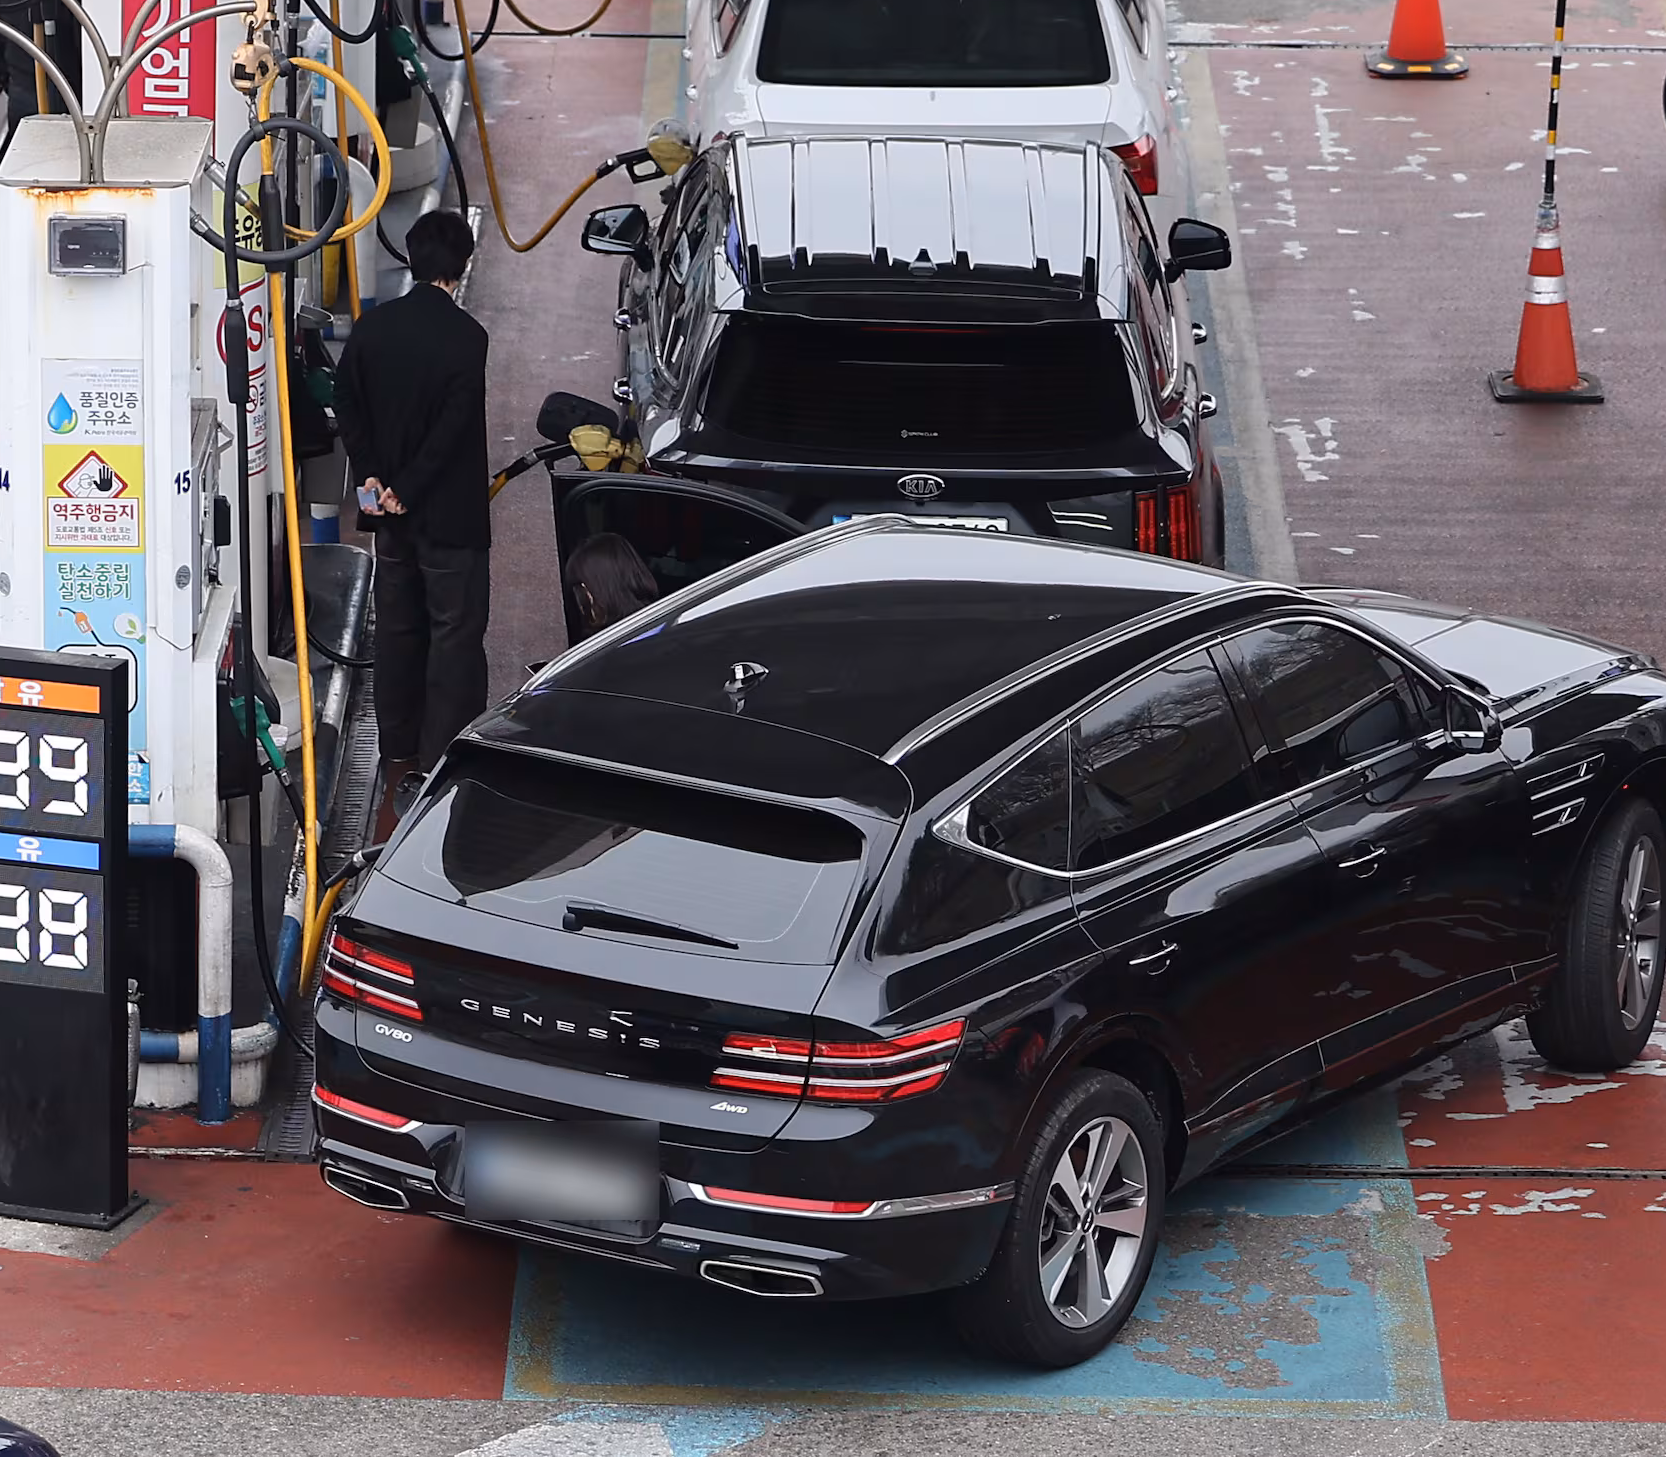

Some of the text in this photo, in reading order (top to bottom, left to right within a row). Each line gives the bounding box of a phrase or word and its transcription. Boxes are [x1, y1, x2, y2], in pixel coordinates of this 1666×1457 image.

[79, 392, 139, 409] 품질인증
[87, 411, 132, 426] 주유소
[174, 470, 191, 494] 15
[906, 479, 939, 493] KIA
[53, 503, 134, 523] 역주행금지
[58, 563, 129, 582] 탄소중립
[59, 582, 129, 600] 실천하기
[374, 1022, 413, 1044] GV80
[459, 997, 662, 1050] GENESIS
